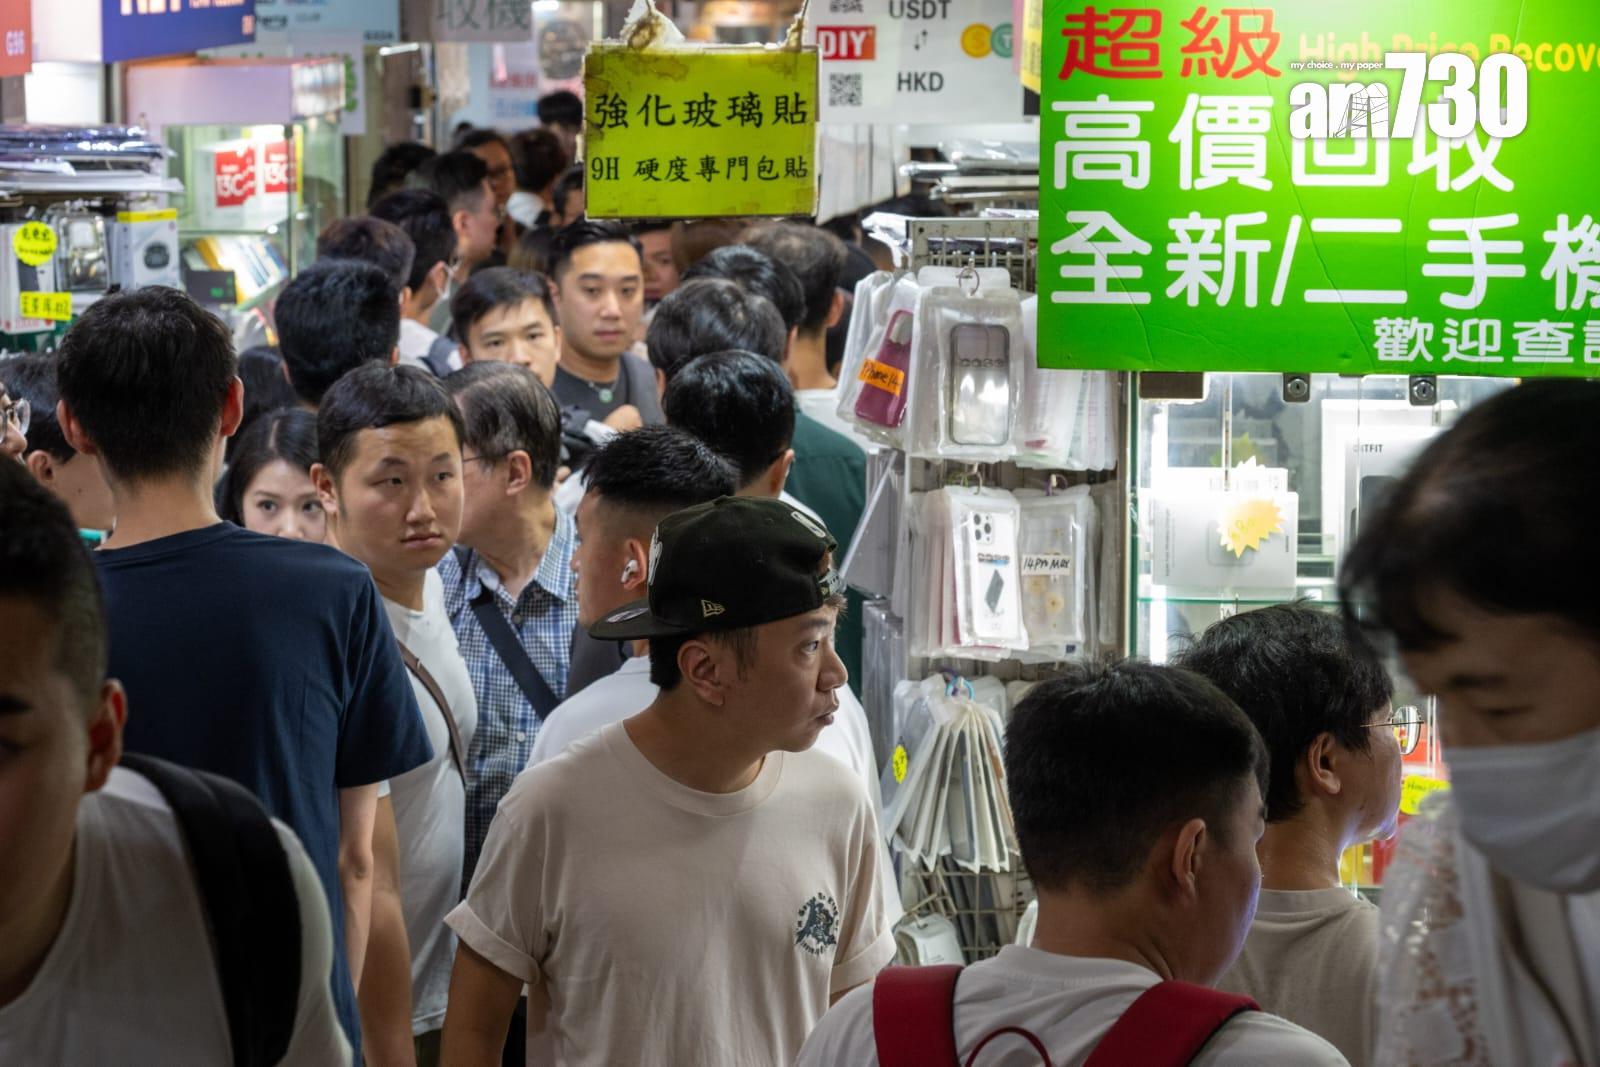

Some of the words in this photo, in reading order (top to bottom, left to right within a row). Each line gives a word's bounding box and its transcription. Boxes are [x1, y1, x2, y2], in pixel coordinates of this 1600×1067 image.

[889, 0, 950, 19] USDT
[819, 31, 867, 57] DIY
[1058, 6, 1282, 81] 超級
[1300, 32, 1382, 80] High
[1490, 34, 1600, 72] Recov
[897, 72, 944, 92] HKD
[593, 91, 809, 129] 強化玻璃貼
[1050, 93, 1515, 193] 高價回收
[591, 156, 620, 181] 9H
[633, 154, 809, 182] 硬度專門包貼
[1373, 317, 1600, 363] 歡迎查
